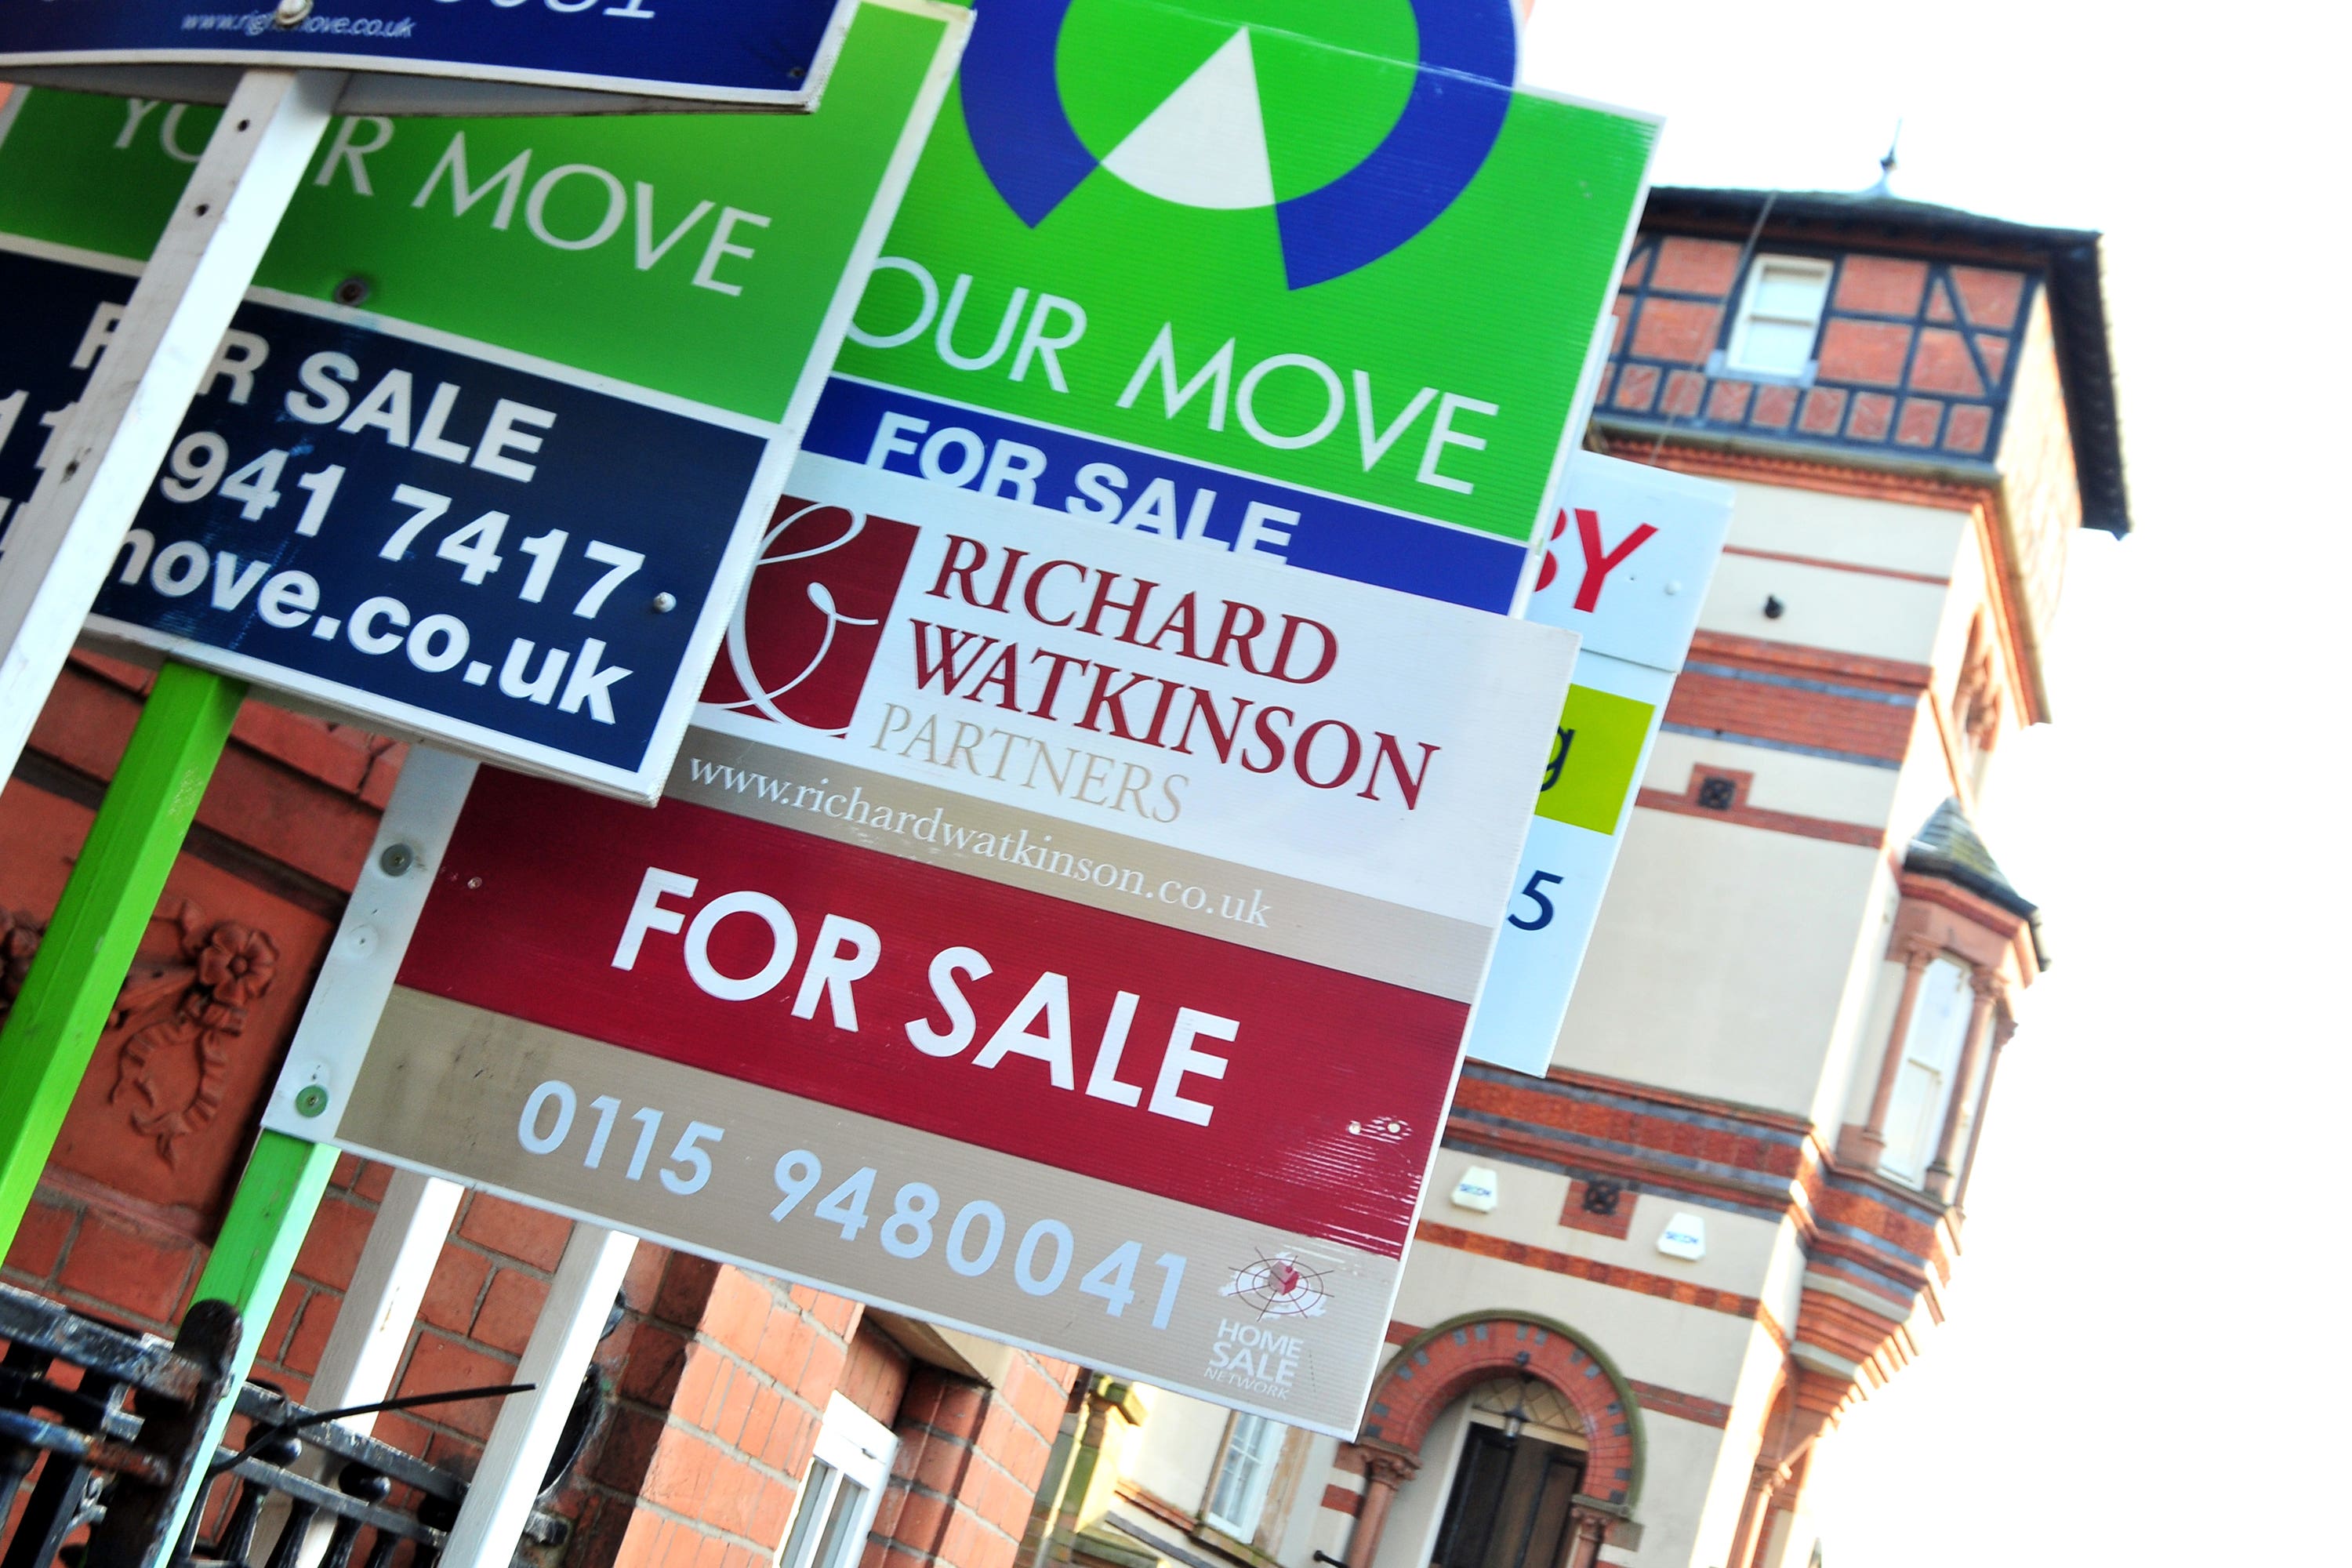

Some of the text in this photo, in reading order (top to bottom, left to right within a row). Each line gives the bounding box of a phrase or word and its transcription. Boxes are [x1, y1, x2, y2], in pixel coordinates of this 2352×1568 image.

[114, 99, 771, 296] YR MOVE
[71, 301, 557, 484] FR SALE
[1115, 321, 1500, 495] MOVE
[160, 430, 347, 538] 941
[379, 483, 646, 619] 7417
[866, 410, 1301, 565] FOR SALE
[926, 534, 1340, 687] RICHARD
[869, 702, 1190, 825] PARTNERS
[906, 618, 1441, 811] WATKINSON
[688, 755, 1273, 928] www.richardwatkinson.co.uk
[611, 866, 1241, 1127] FOR SALE
[517, 1079, 1187, 1330] 0115 9480041
[1204, 1367, 1291, 1401] NETWORK
[1208, 1341, 1299, 1387] SALE
[1218, 1318, 1305, 1360] HOME
